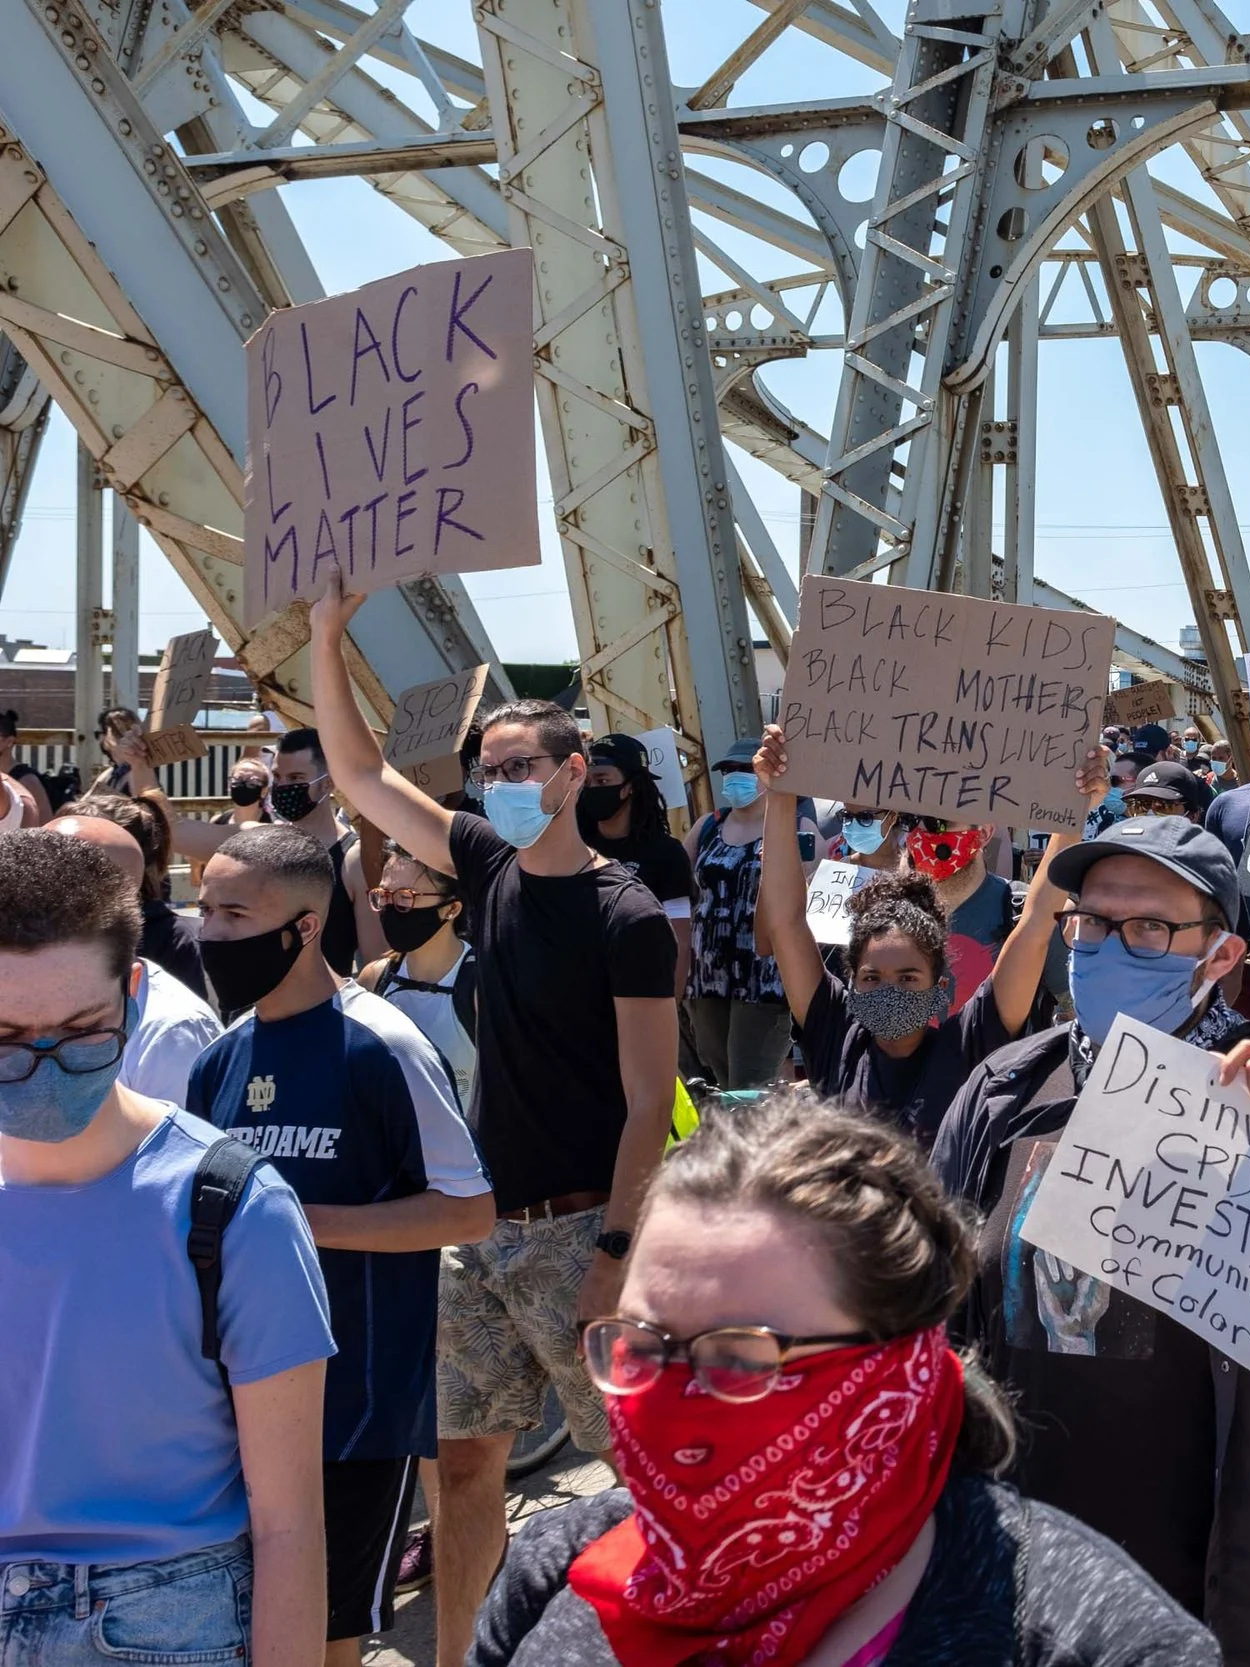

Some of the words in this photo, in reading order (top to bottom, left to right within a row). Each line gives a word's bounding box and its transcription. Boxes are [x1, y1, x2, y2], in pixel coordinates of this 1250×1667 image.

[261, 271, 498, 430] BLACK
[266, 382, 478, 525] LIVES
[264, 488, 486, 607] MATTER
[818, 588, 955, 647] BLACK
[803, 649, 910, 698] BLACK
[396, 676, 487, 735] STOP
[388, 717, 468, 760] KILLING
[783, 703, 879, 746] BLACK
[892, 712, 994, 770] TRANS
[1000, 727, 1084, 770] LIVES
[852, 757, 1020, 812] MATTER
[1101, 1257, 1142, 1286] of
